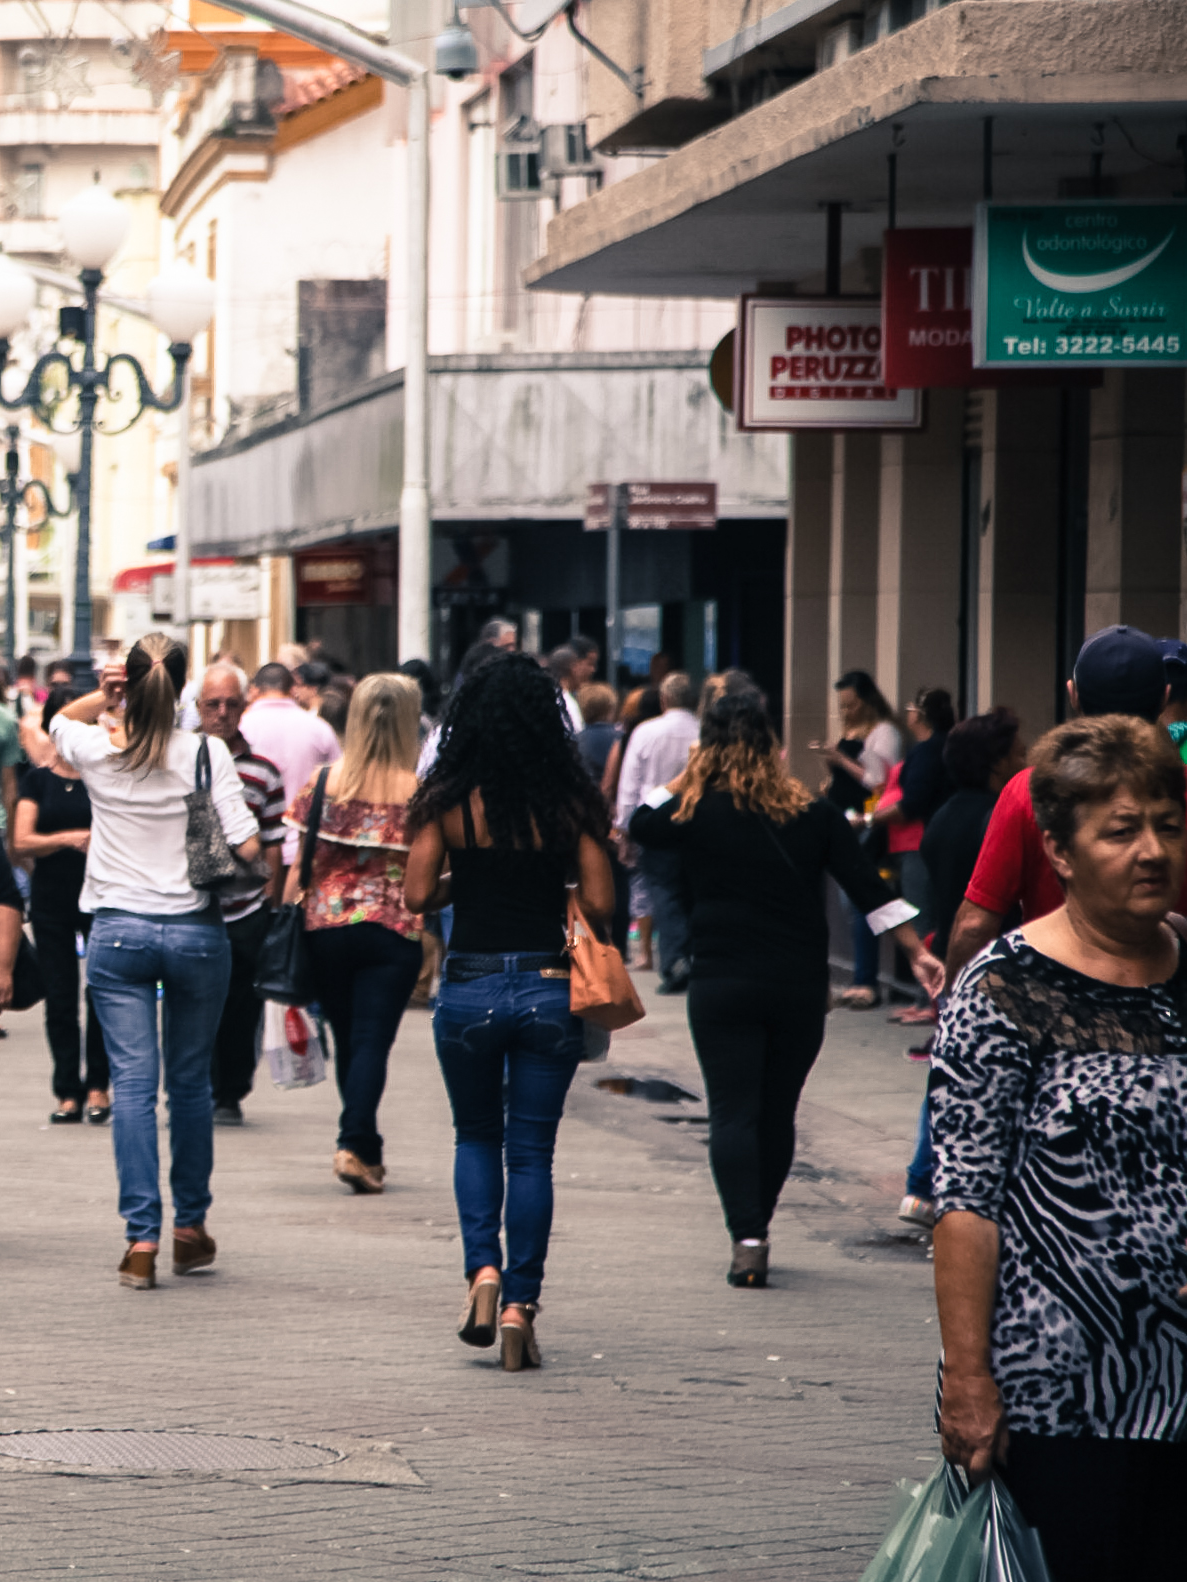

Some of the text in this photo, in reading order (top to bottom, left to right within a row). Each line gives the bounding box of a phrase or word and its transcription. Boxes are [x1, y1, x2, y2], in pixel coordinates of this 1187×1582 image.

[1065, 213, 1118, 228] centro
[1037, 234, 1148, 254] odontológico
[1013, 296, 1167, 318] Volte a Sorrir
[786, 326, 881, 351] PHOTO
[1002, 334, 1181, 355] Tel: 3222-5445
[771, 356, 880, 381] PERUZZ
